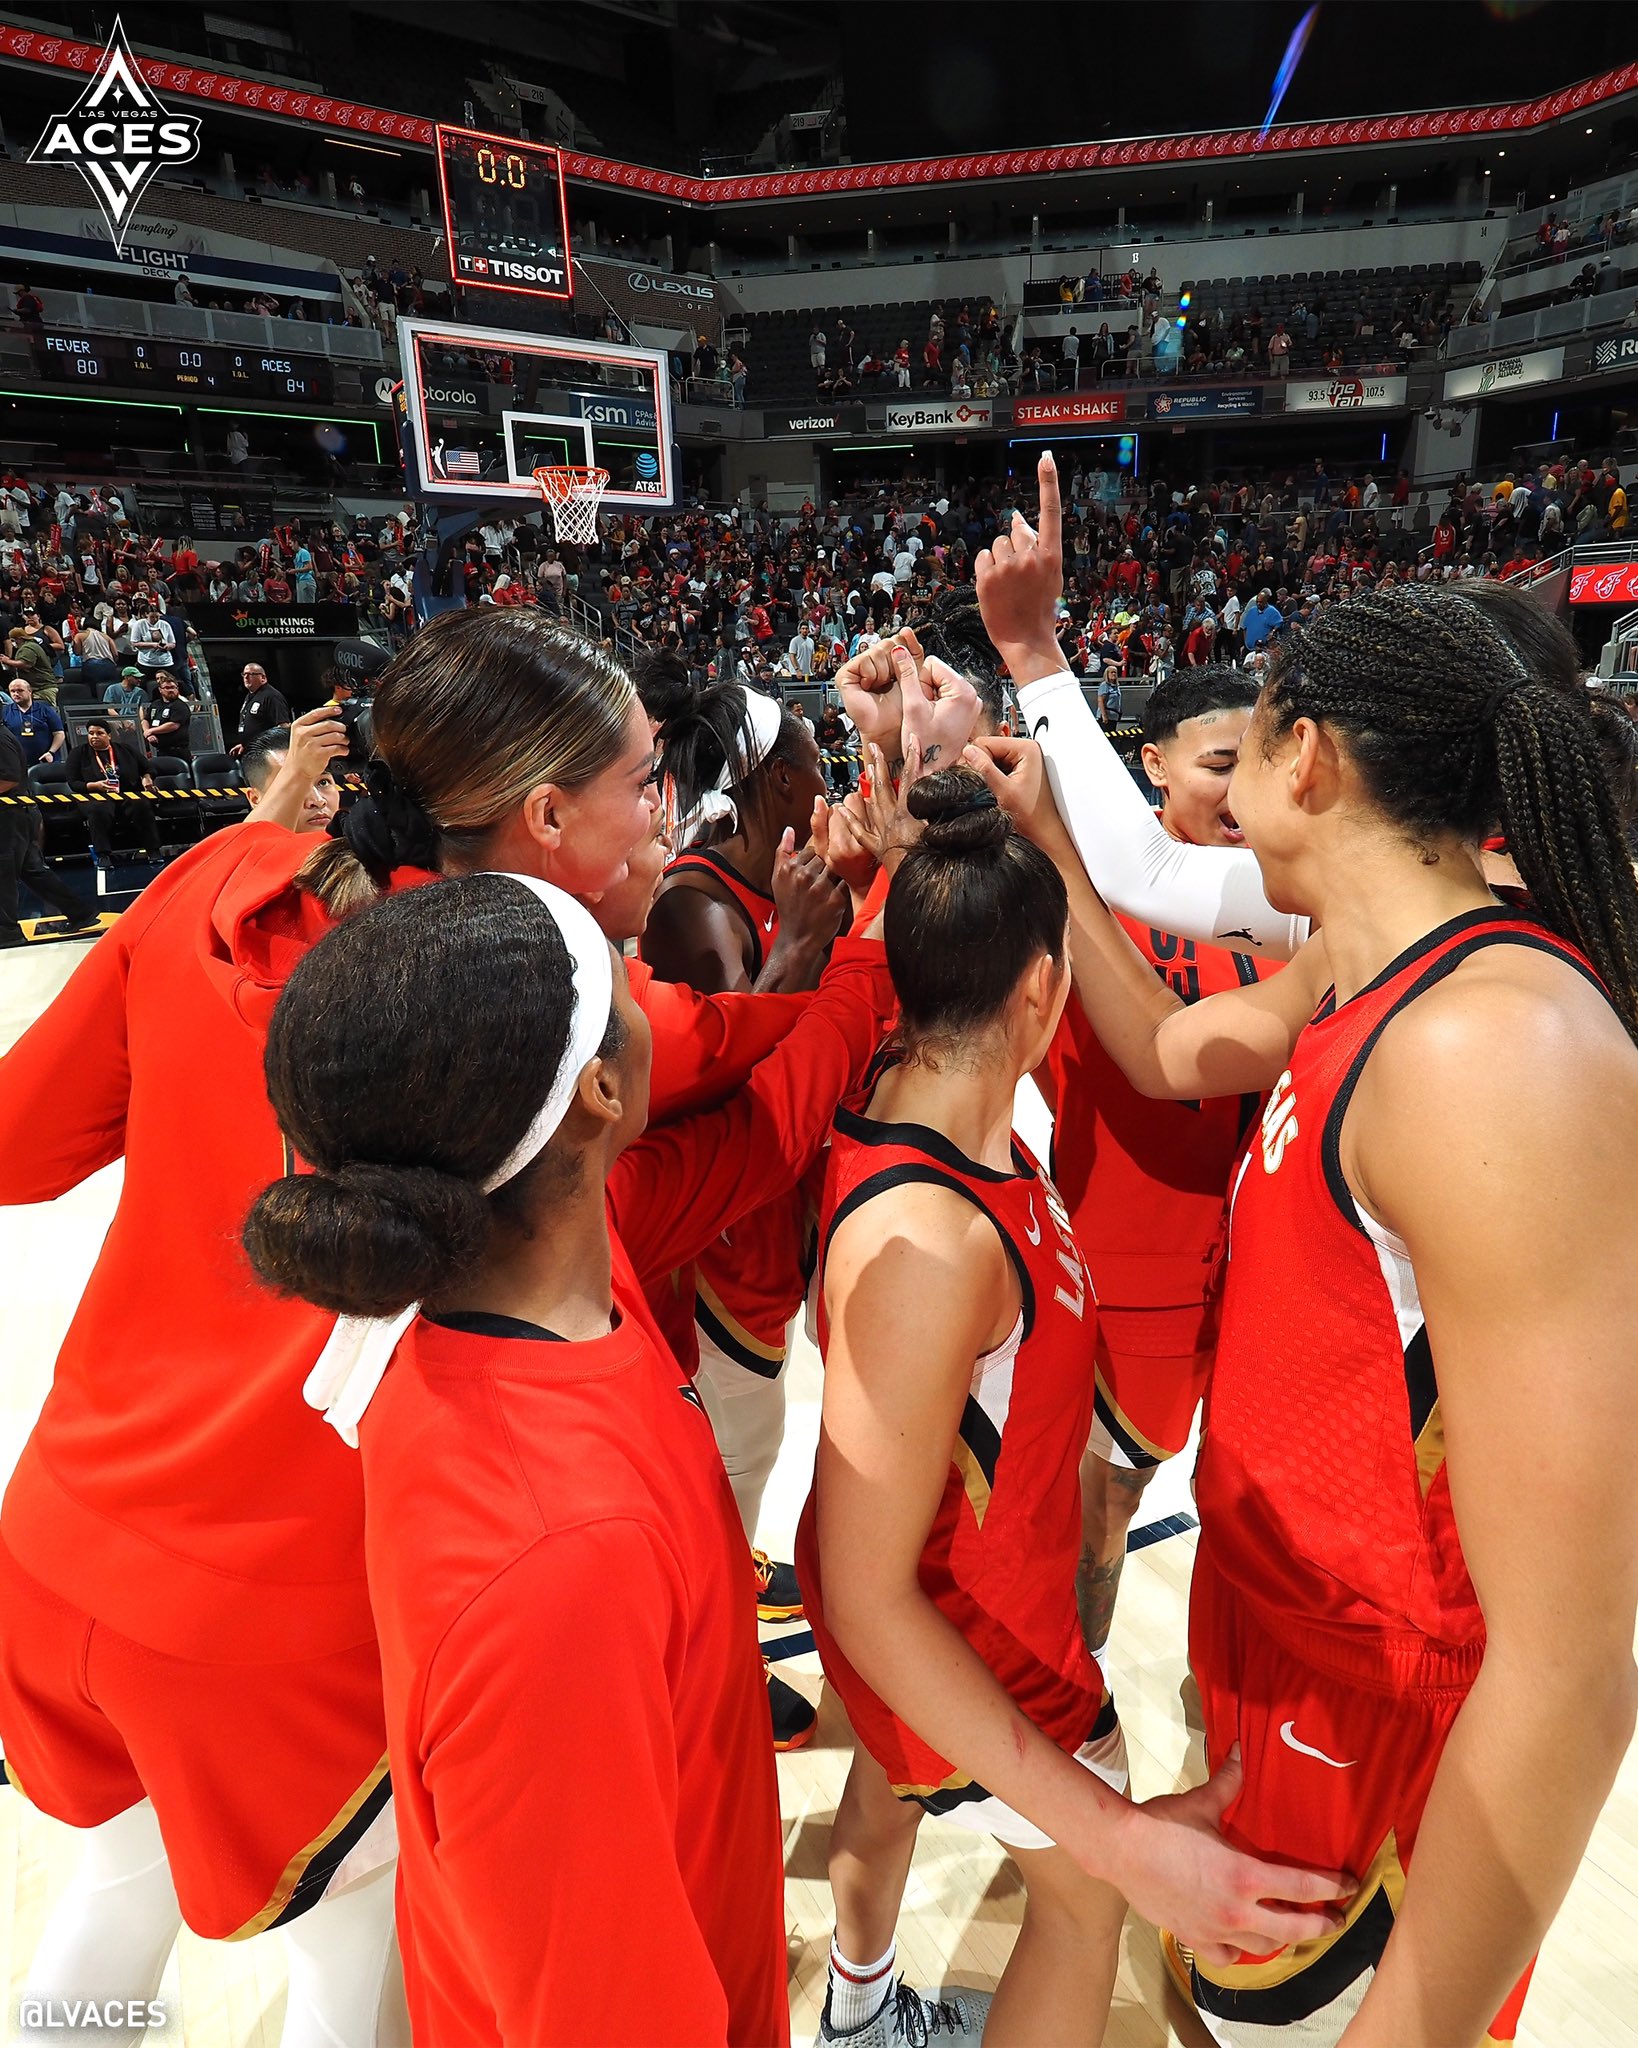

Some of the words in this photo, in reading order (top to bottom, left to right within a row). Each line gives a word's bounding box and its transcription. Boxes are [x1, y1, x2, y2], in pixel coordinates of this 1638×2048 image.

[477, 148, 526, 189] 0.0
[119, 246, 189, 269] FLIGHT
[142, 267, 172, 279] DECK
[488, 259, 564, 285] TISSOT
[652, 279, 714, 299] LEXUS
[46, 337, 91, 354] FEVER
[180, 351, 202, 368] 0.0
[261, 359, 292, 373] ACES
[76, 359, 98, 375] 80
[207, 376, 215, 386] 4
[286, 379, 305, 393] 84
[422, 386, 477, 405] otorola
[1308, 390, 1326, 401] 93.5
[1327, 381, 1356, 396] the
[1366, 386, 1385, 398] 107.5
[1333, 394, 1363, 408] fan
[580, 397, 628, 424] ksm
[634, 409, 653, 419] CPAs
[1017, 405, 1061, 419] STEAK
[1072, 401, 1118, 416] SHAKE
[788, 416, 835, 430] verizon
[888, 410, 954, 428] KeyBank
[635, 480, 662, 493] AT&T
[235, 617, 315, 628] DRAFTKINGS
[256, 627, 315, 635] SPORTSBOOK
